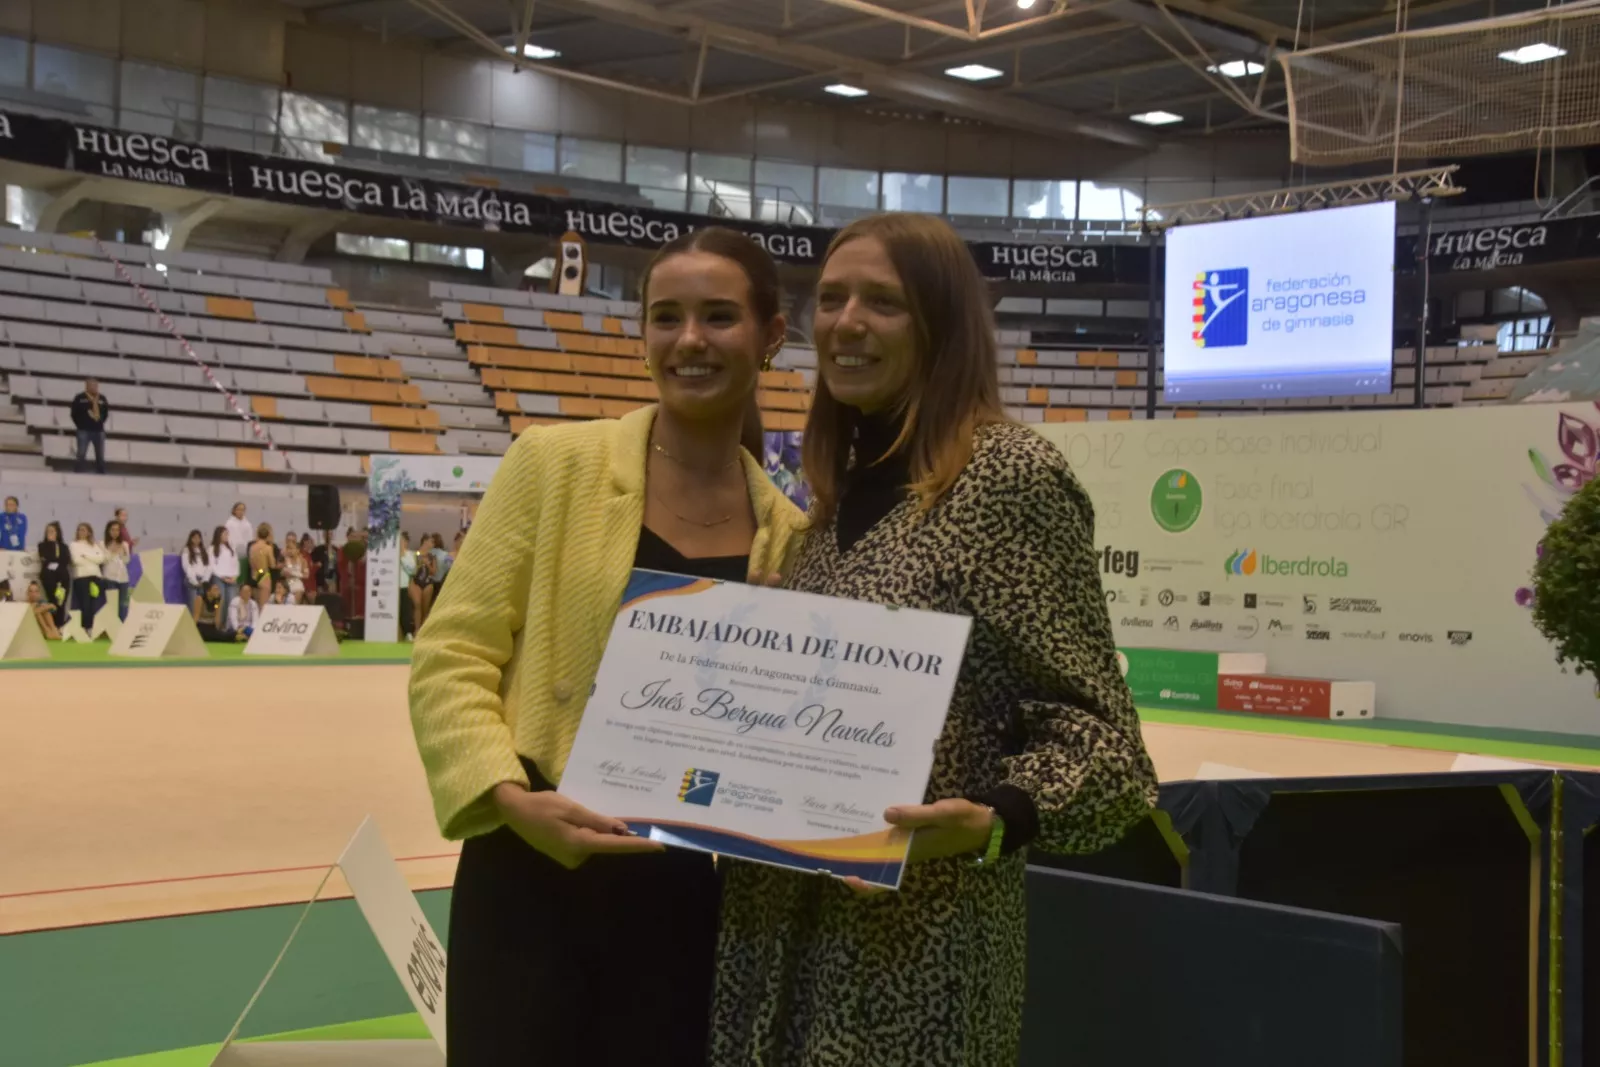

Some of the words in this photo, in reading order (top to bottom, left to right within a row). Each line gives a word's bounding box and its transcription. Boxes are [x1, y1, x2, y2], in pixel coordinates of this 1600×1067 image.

[1266, 272, 1351, 292] federación
[1250, 288, 1367, 315] aragonesa
[1261, 316, 1282, 332] de
[1284, 311, 1355, 333] gimnasia
[1143, 432, 1209, 464] Copa
[1214, 427, 1273, 456] Base
[1270, 472, 1315, 501] final
[1370, 502, 1411, 532] GR
[1261, 554, 1349, 578] Iberdrola
[262, 615, 309, 635] divina
[627, 609, 794, 654] EMBAJADORA
[801, 634, 839, 661] DE
[839, 641, 943, 677] HONOR
[659, 650, 674, 663] De
[675, 652, 687, 665] la
[687, 655, 749, 674] Federación
[749, 663, 807, 685] Aragonesa
[809, 672, 824, 685] de
[825, 676, 883, 696] Gimnasia.
[620, 678, 686, 713] Inés
[689, 687, 788, 735] Bergua
[794, 702, 897, 749] Navales
